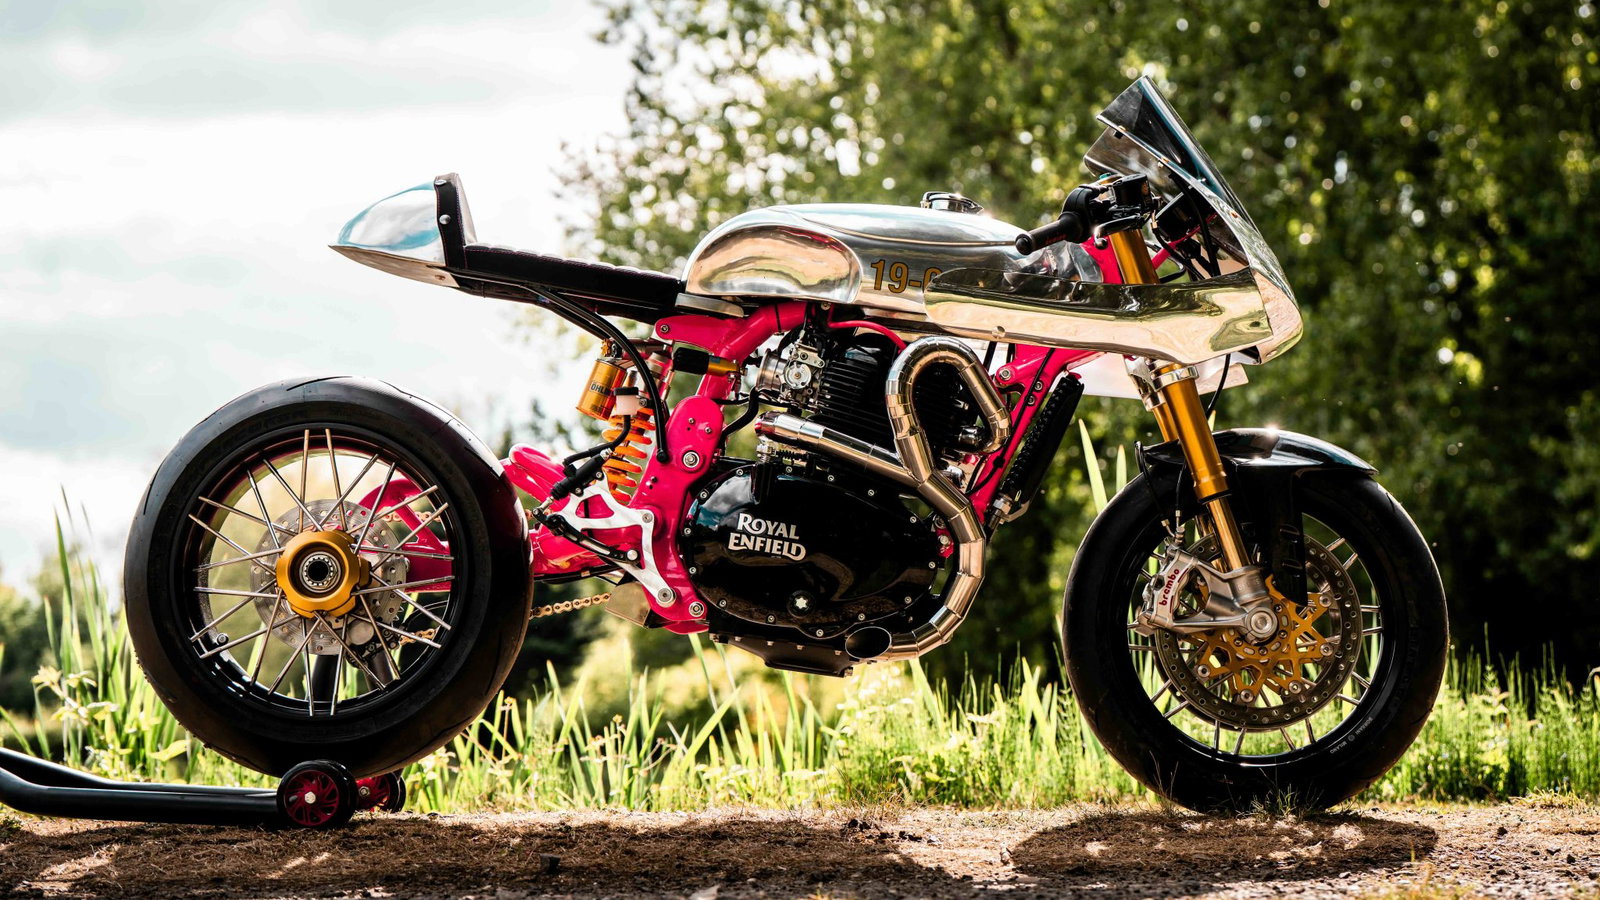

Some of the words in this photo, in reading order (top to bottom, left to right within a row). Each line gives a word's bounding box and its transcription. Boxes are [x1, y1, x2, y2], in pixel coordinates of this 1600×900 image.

[737, 512, 800, 540] ROYAL
[727, 532, 807, 561] ENFIELD
[1158, 568, 1181, 607] brembo
